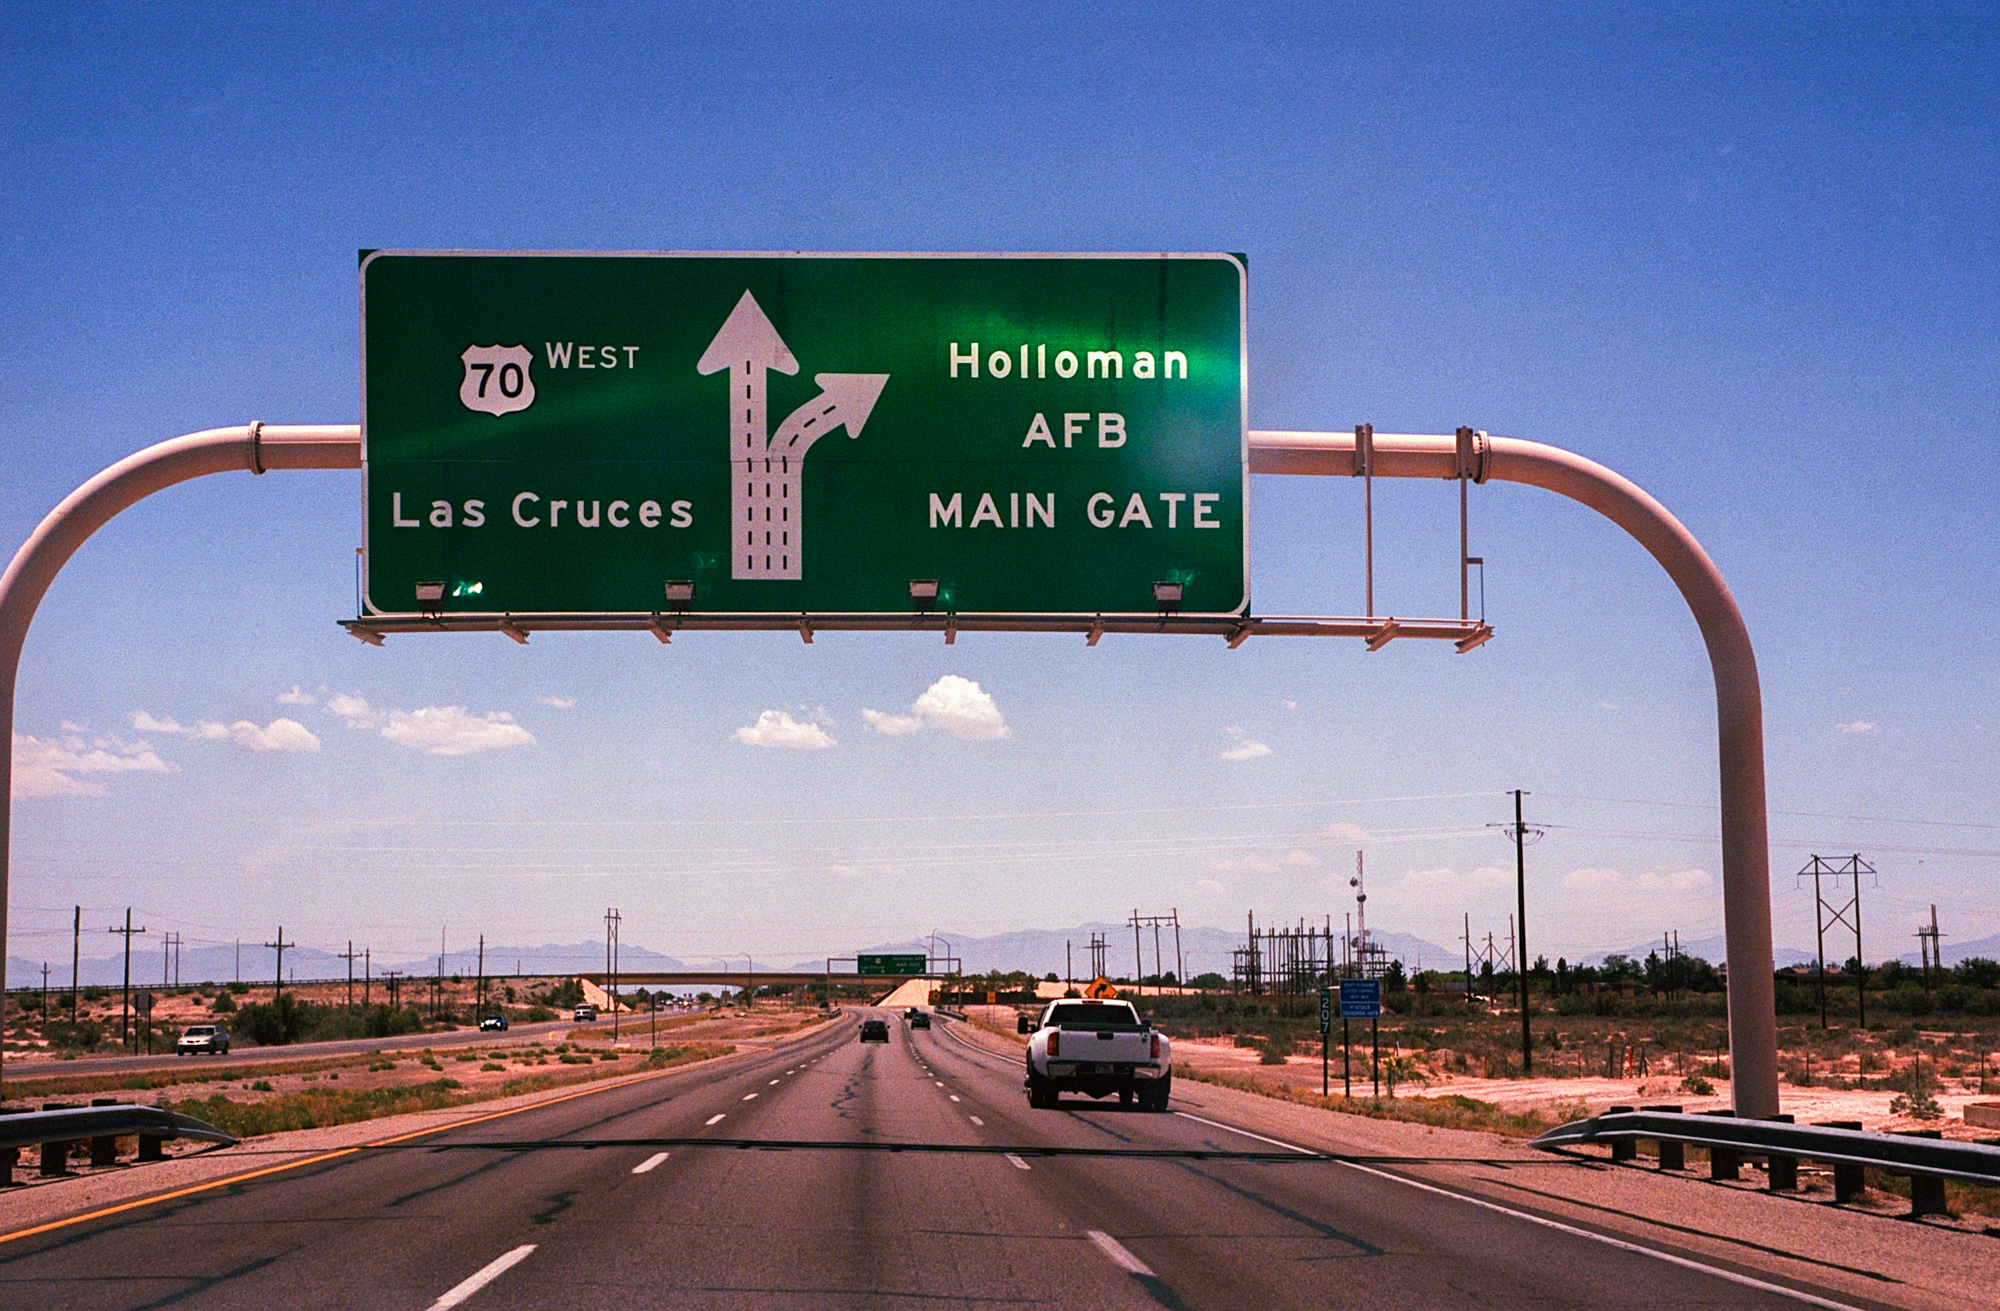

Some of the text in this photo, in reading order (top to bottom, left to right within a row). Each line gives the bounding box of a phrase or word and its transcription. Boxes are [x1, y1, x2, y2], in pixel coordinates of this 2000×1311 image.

[546, 342, 639, 368] WEST
[950, 343, 1187, 379] Holloman
[471, 363, 523, 398] 70
[1022, 413, 1126, 447] AFB
[394, 492, 692, 527] Las Cruces
[930, 492, 1220, 528] MAIN GATE
[1321, 997, 1330, 1032] 207
